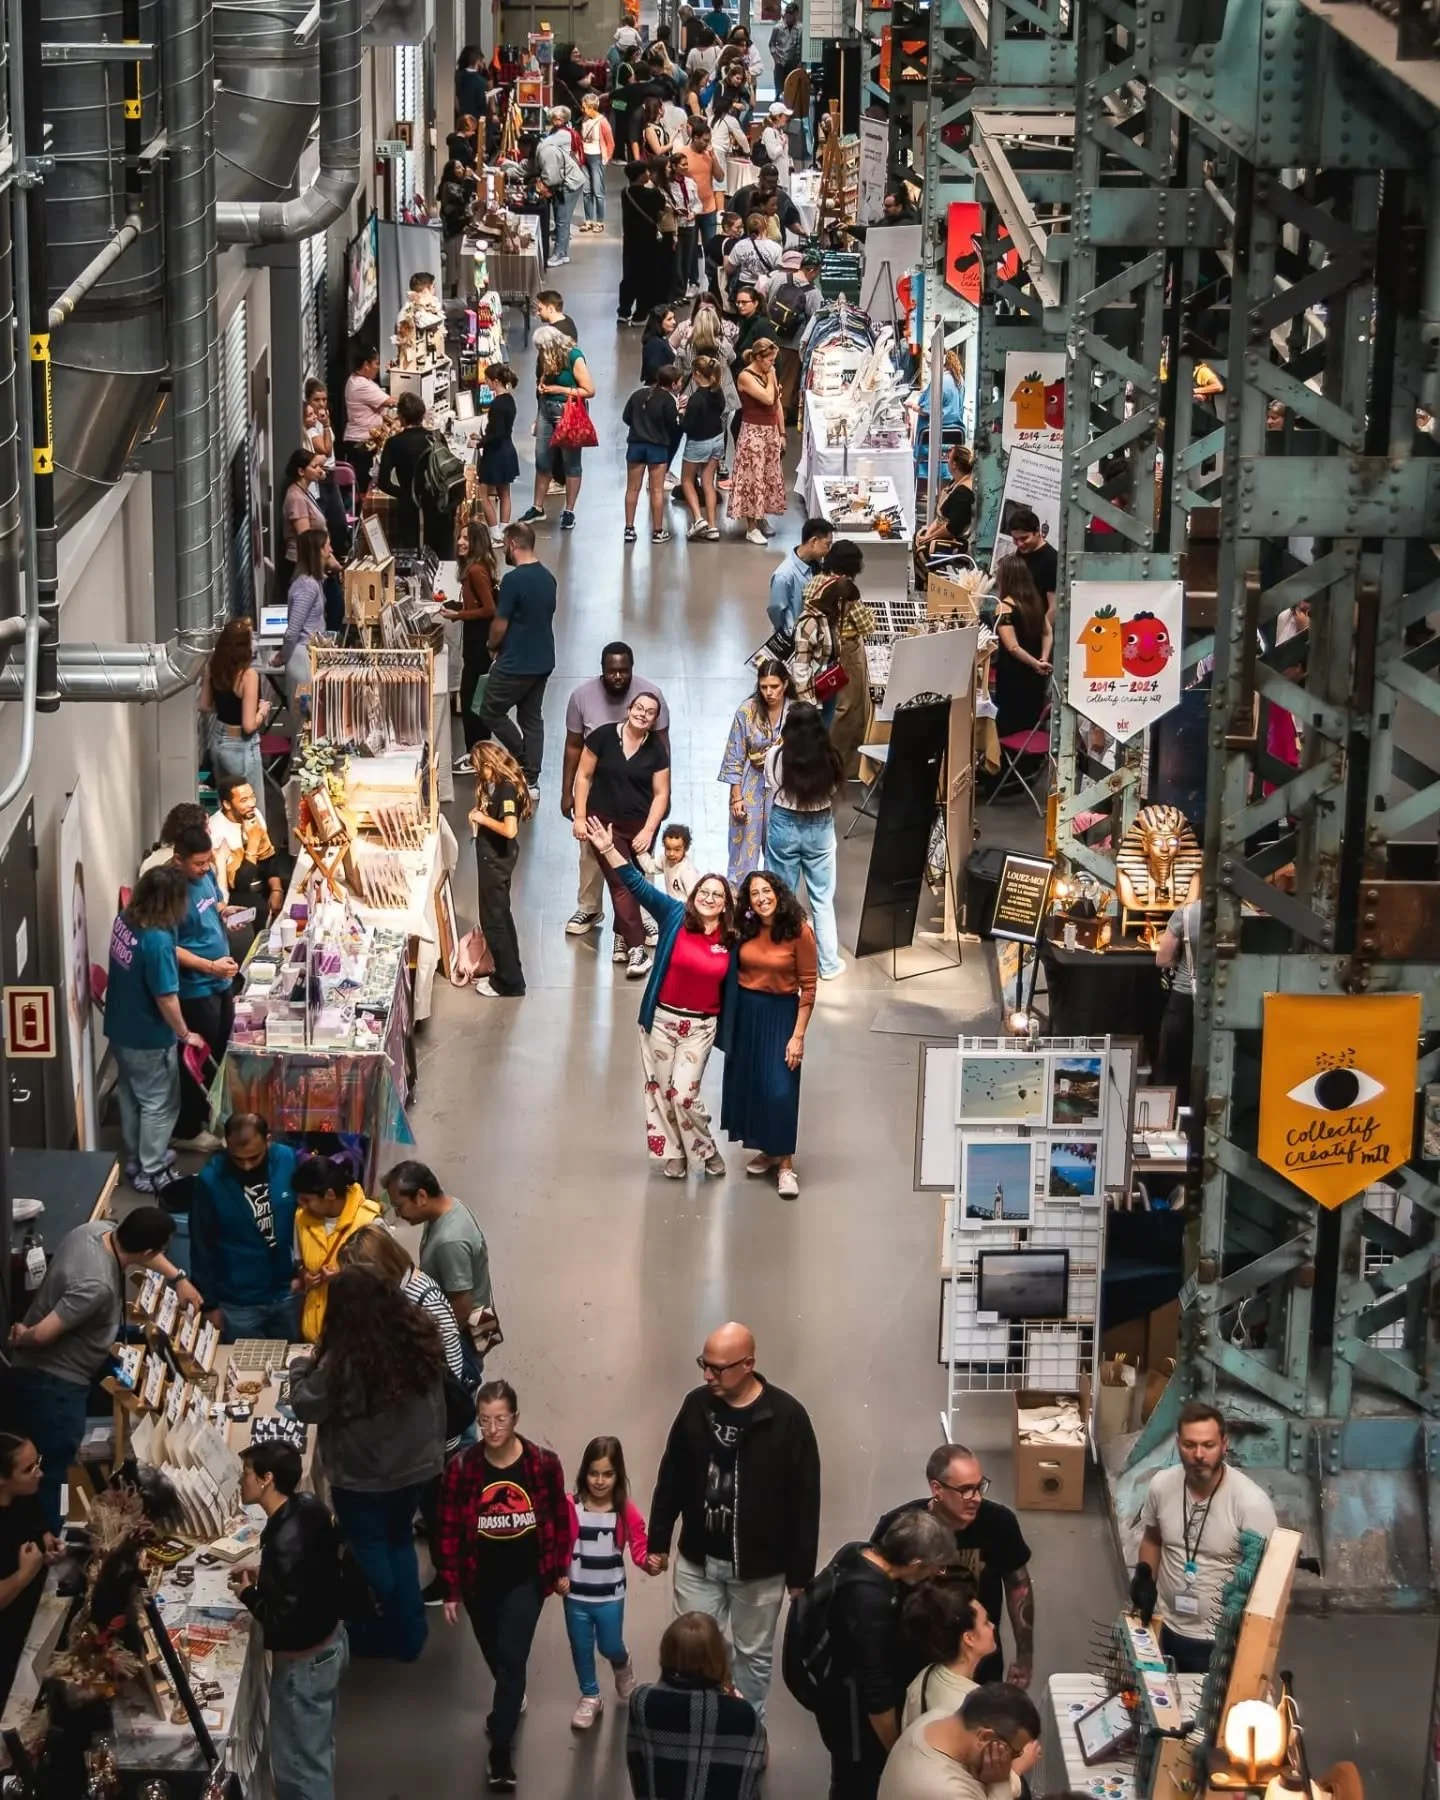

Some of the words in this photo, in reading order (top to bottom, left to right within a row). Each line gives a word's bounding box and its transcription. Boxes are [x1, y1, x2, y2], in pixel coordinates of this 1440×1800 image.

[1049, 432, 1064, 441] 20
[1089, 680, 1116, 692] 2014
[1129, 680, 1159, 693] 2024
[1006, 870, 1045, 886] LOUEZ-MOI
[1361, 1144, 1390, 1165] mtl
